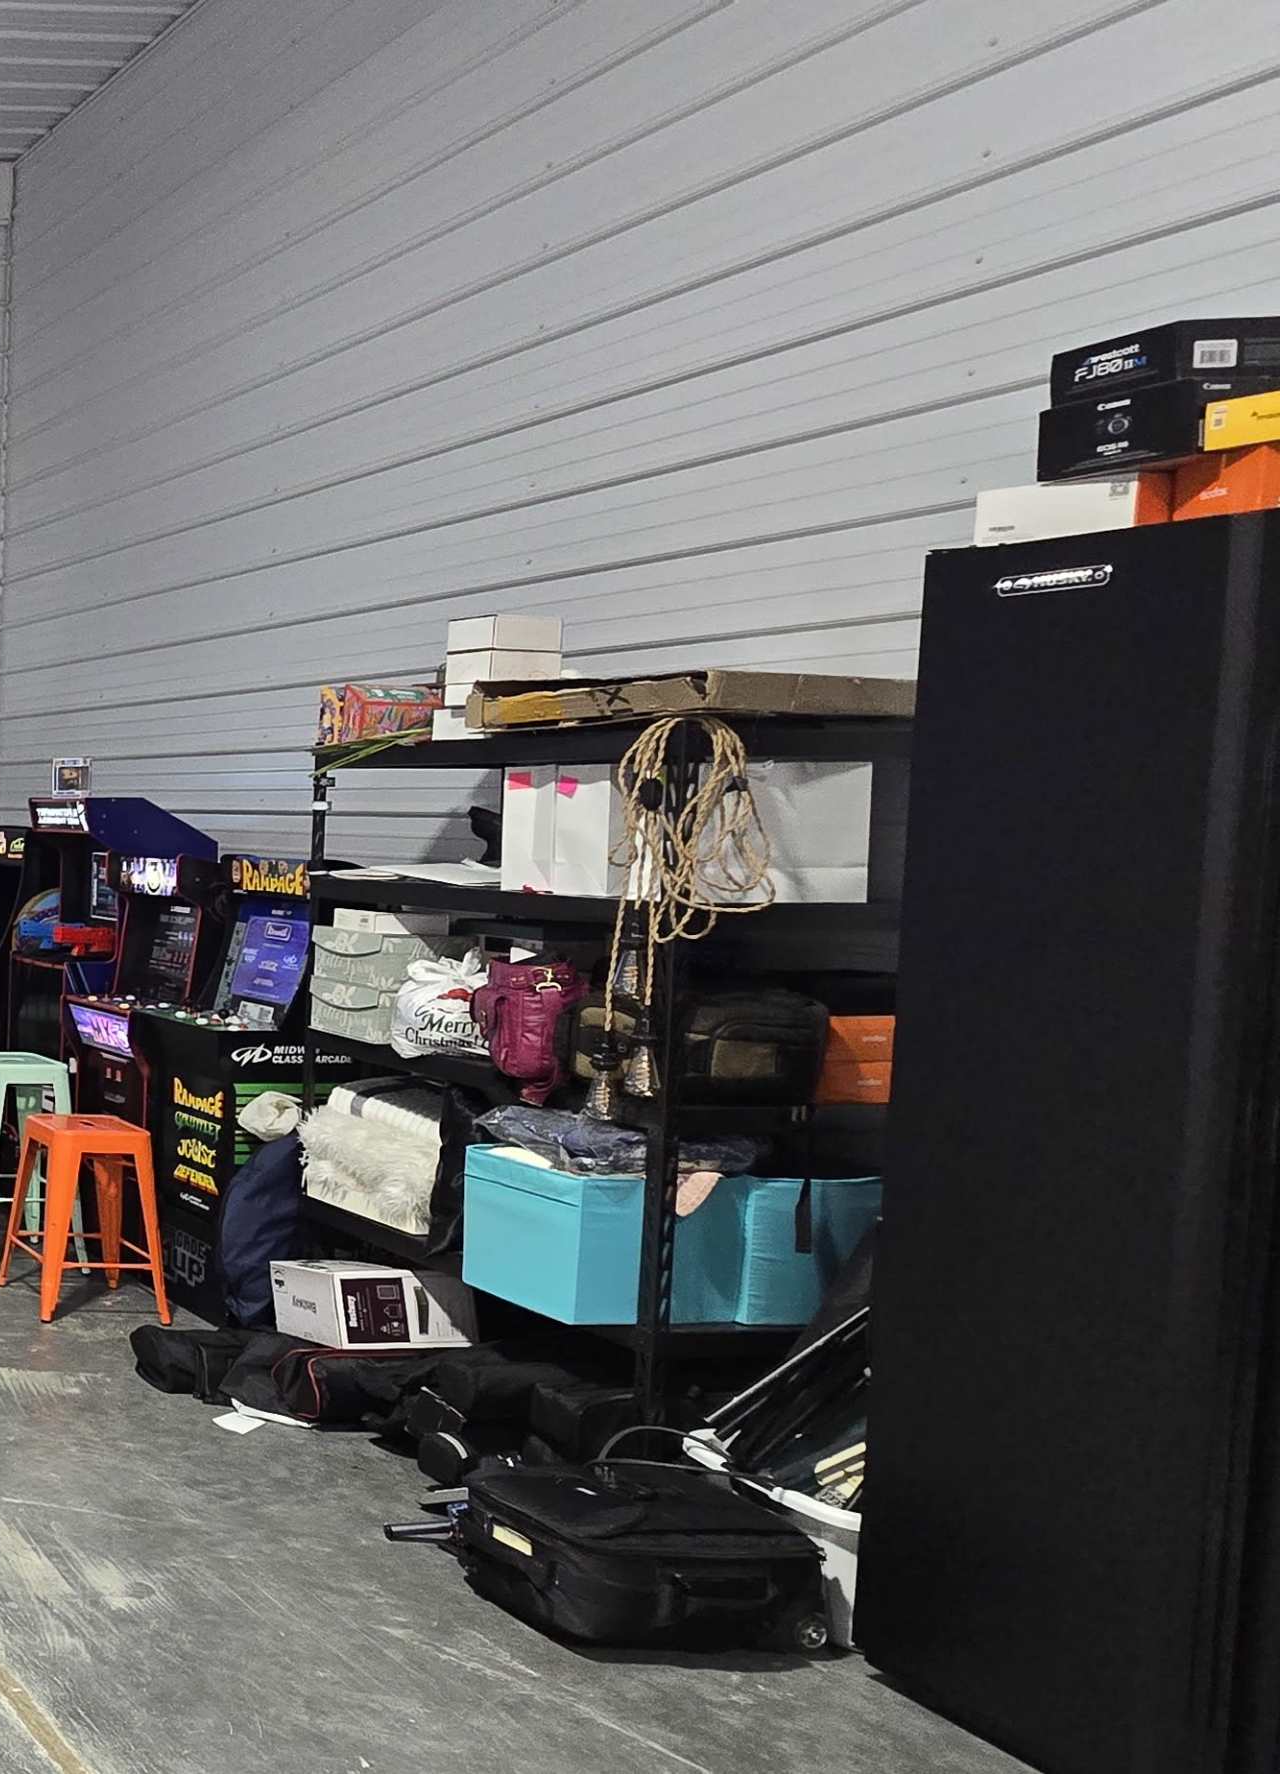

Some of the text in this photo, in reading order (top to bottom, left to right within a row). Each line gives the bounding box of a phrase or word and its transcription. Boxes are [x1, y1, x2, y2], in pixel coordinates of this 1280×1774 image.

[242, 859, 305, 896] RAMPAGE
[419, 1013, 475, 1037] Merry
[272, 1055, 304, 1065] CLASS
[173, 1077, 224, 1118] RAMPAGE
[177, 1138, 217, 1169] JOUST
